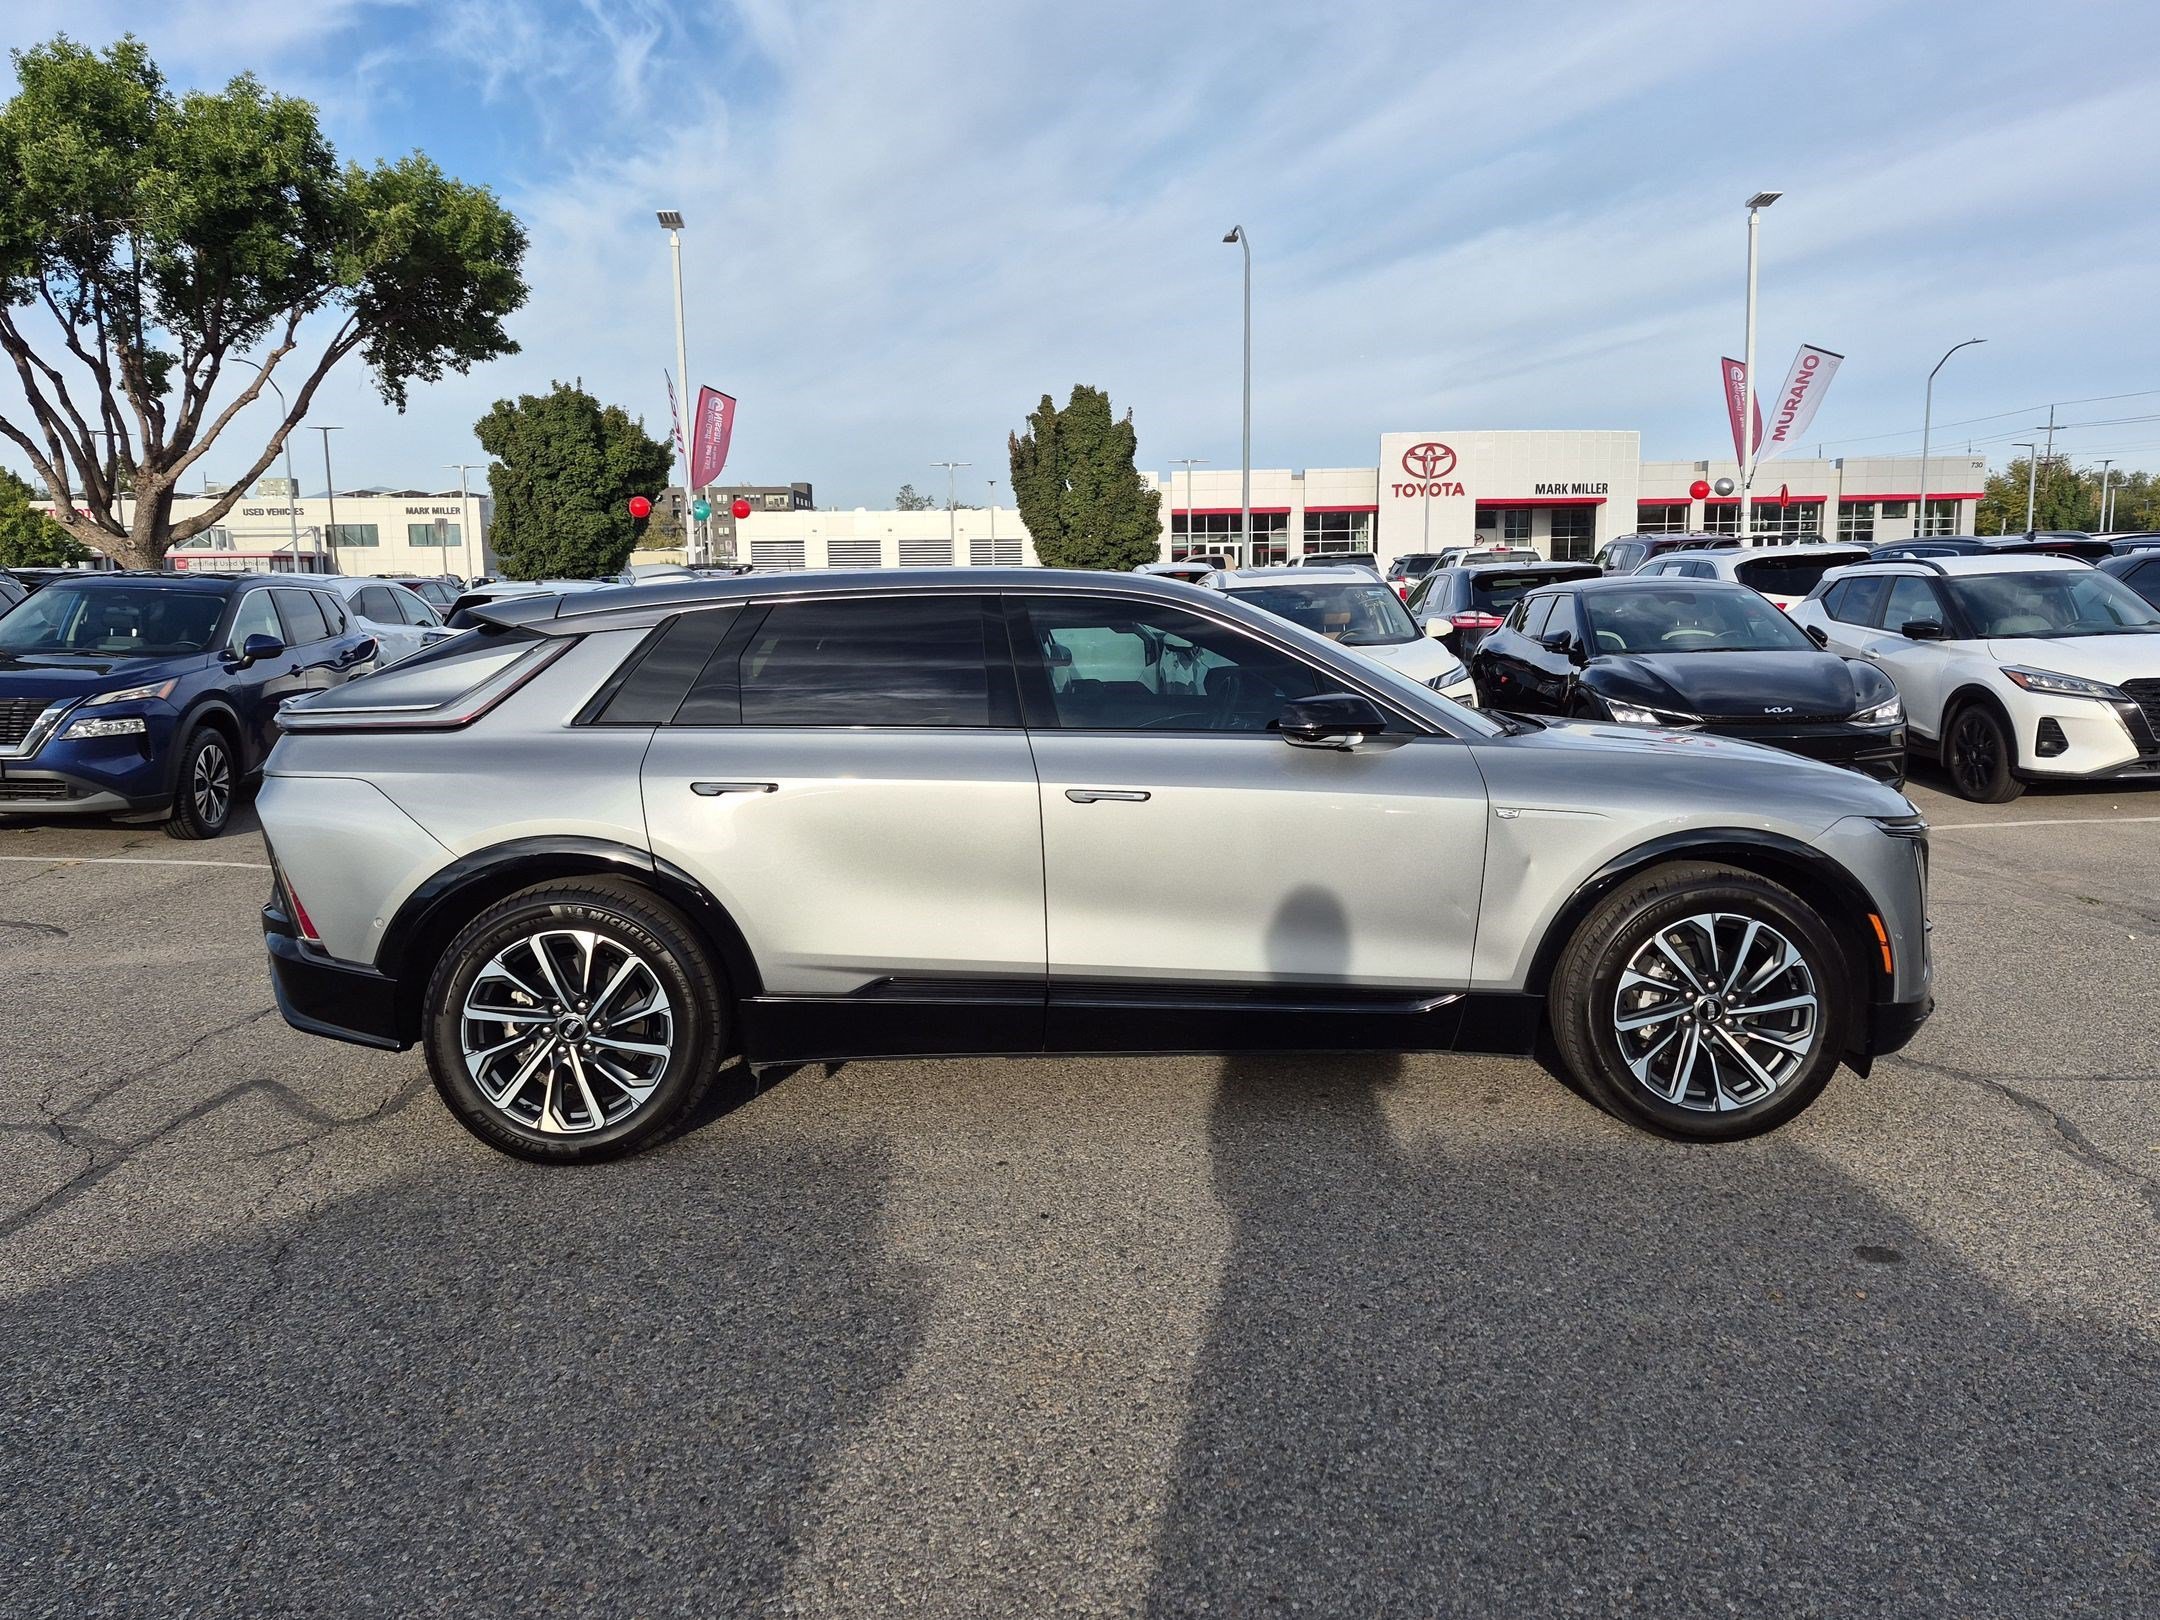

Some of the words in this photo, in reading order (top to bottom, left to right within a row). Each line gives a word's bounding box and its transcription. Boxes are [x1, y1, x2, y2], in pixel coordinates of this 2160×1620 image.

[1772, 355, 1820, 441] MURANO
[1971, 461, 1984, 469] 730
[1391, 482, 1466, 498] TOYOTA
[1535, 483, 1569, 495] MARK
[1571, 483, 1609, 495] MILLER
[243, 507, 265, 516] USED
[266, 507, 305, 516] VEHICES
[405, 506, 430, 515] MARK
[431, 506, 461, 515] MILLER
[588, 910, 661, 952] MICHELIN
[471, 1112, 546, 1153] MICHELIN
